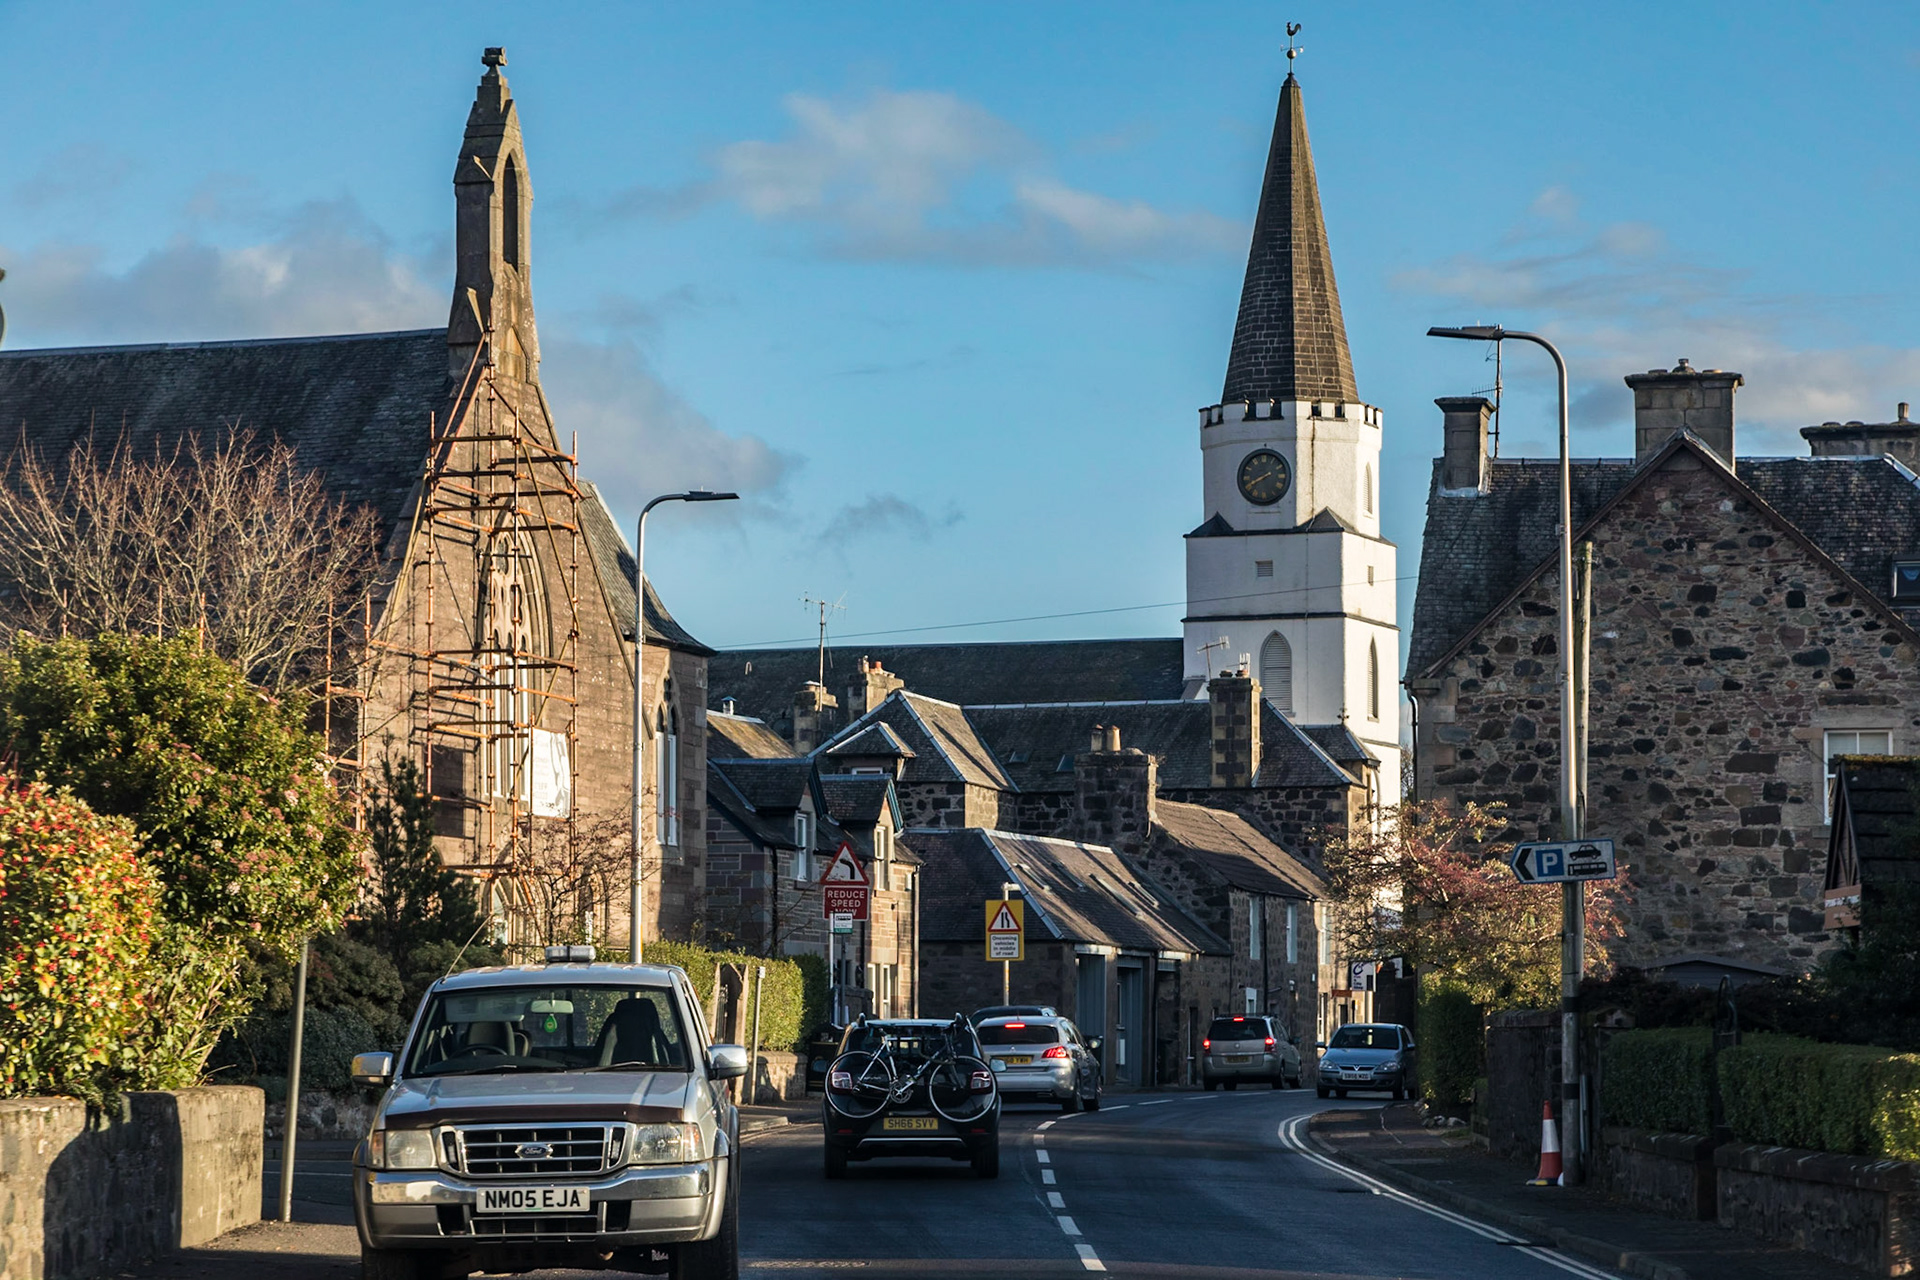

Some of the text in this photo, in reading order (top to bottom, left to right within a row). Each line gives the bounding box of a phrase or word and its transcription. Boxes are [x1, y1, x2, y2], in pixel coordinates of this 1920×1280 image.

[1542, 852, 1558, 874] P
[827, 890, 865, 899] REDUCE
[831, 899, 861, 908] SPEED
[888, 1118, 914, 1128] SH66
[524, 1147, 543, 1155] Ford
[485, 1189, 581, 1209] NM05 EJA
